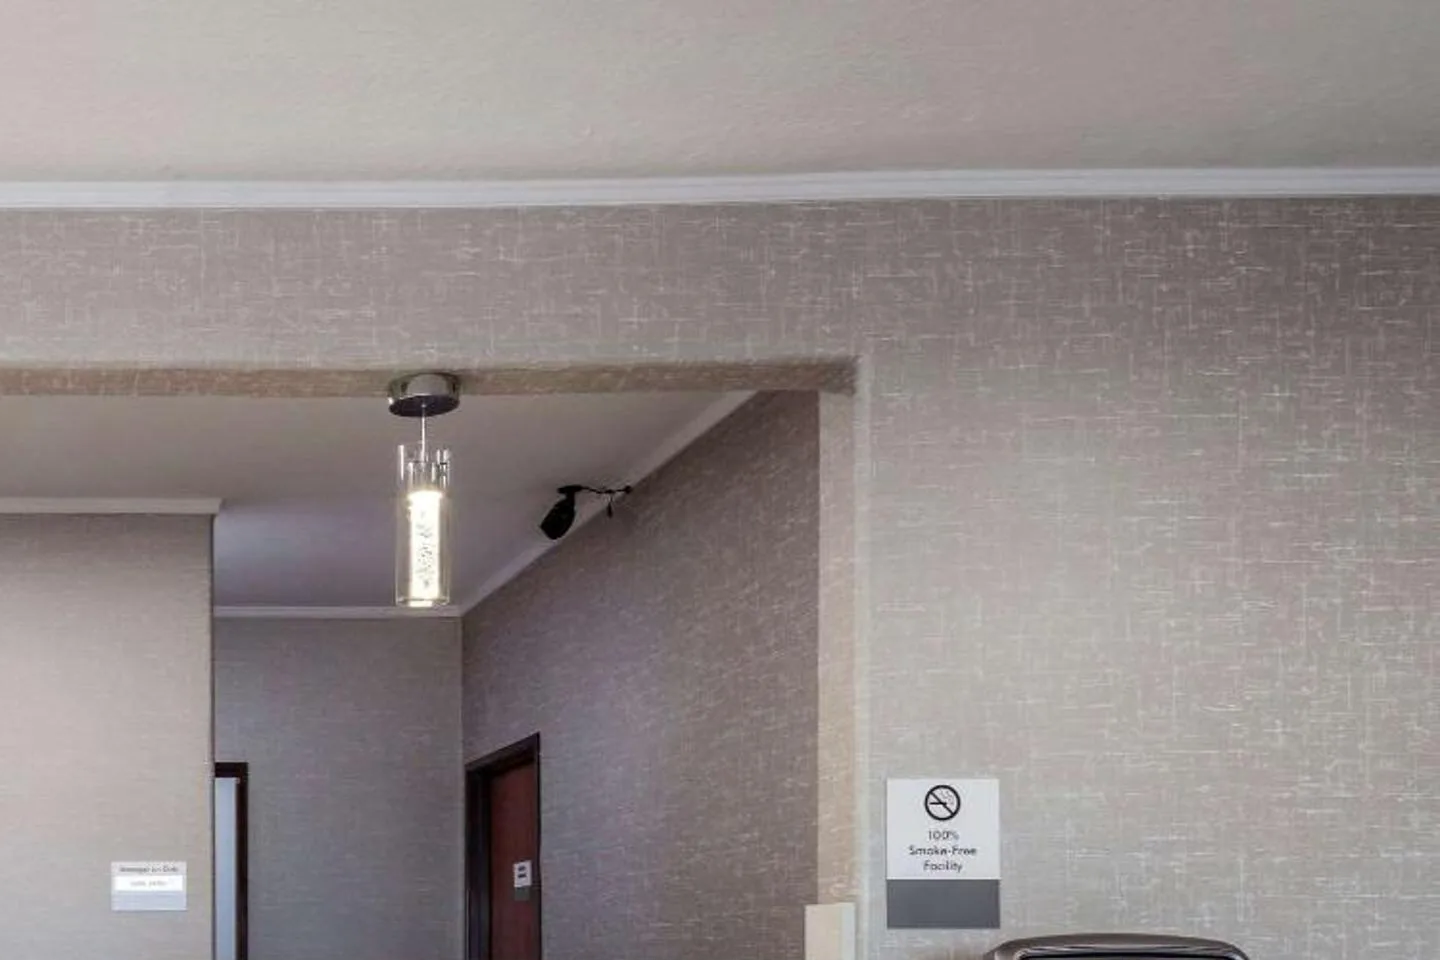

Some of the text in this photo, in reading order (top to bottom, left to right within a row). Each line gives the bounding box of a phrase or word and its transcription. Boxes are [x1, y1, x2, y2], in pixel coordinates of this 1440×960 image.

[928, 830, 959, 841] 100%
[908, 845, 977, 856] Smoke-Free
[923, 860, 963, 872] Facility
